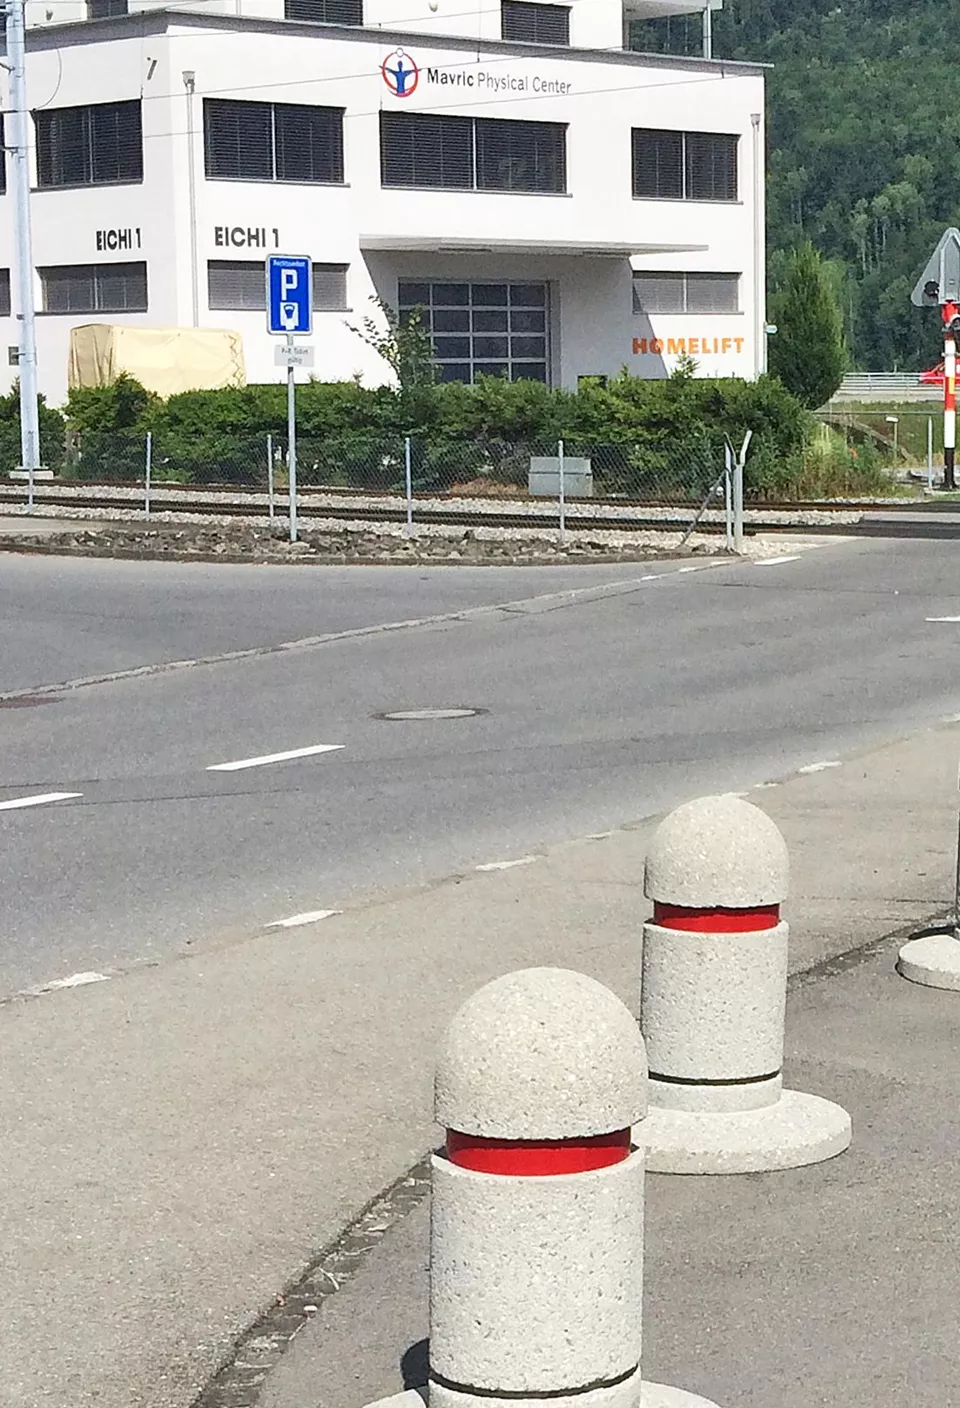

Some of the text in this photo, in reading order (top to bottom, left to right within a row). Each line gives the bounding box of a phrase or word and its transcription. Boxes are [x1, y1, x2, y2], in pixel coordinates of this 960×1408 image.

[427, 67, 572, 94] Mavric Physical Center
[96, 227, 141, 251] EICHI 1
[214, 226, 280, 248] EICHI 1
[281, 268, 298, 301] P
[632, 337, 745, 355] HOMELIFT
